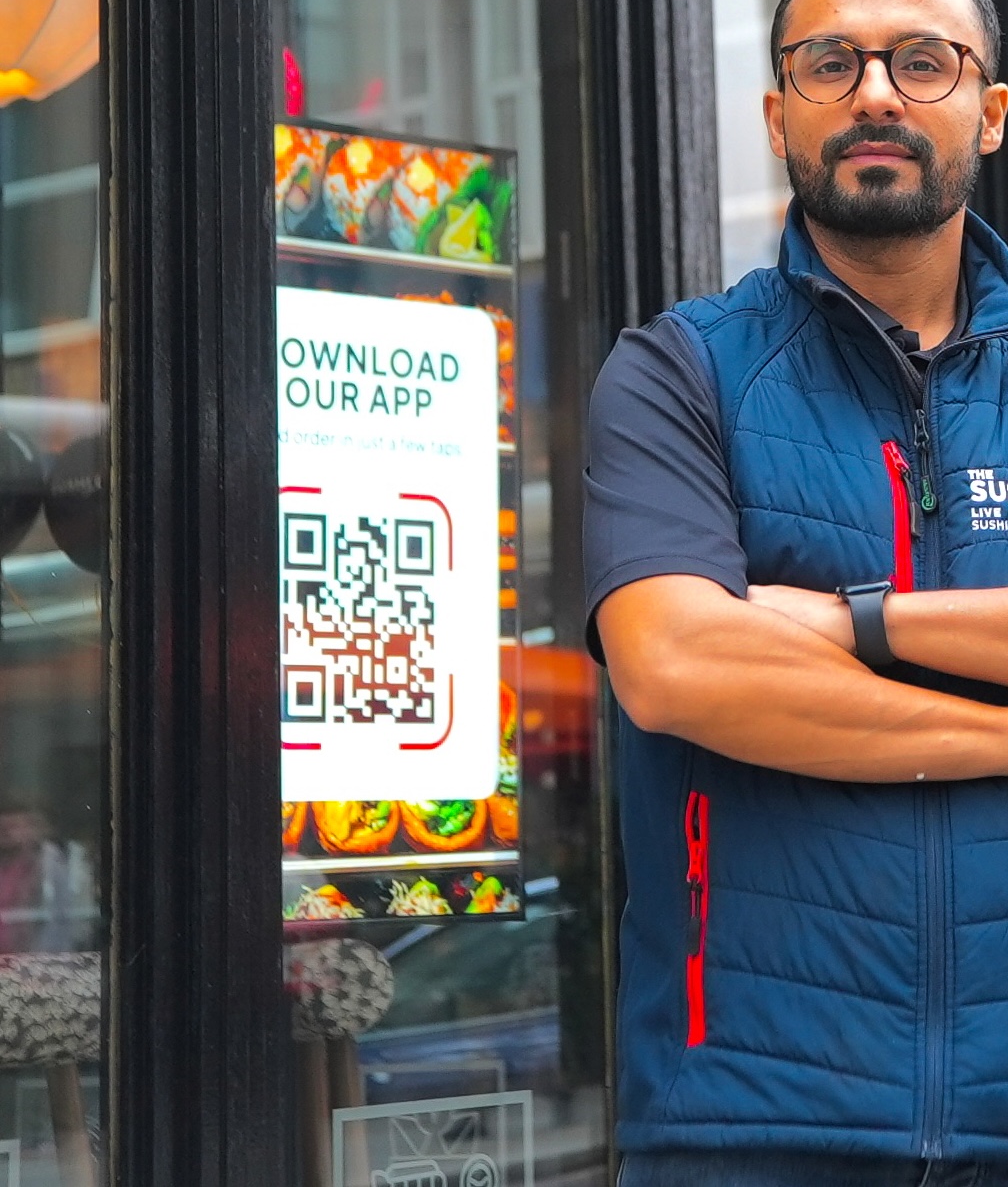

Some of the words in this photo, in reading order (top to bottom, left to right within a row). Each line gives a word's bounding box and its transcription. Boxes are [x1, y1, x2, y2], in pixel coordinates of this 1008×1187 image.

[281, 337, 460, 383] OWNLOAD
[286, 376, 359, 413] OUR
[369, 384, 433, 417] APP
[293, 430, 335, 446] order
[967, 469, 994, 480] THE
[971, 507, 1001, 518] LIVE
[971, 519, 1008, 531] SUSHI
